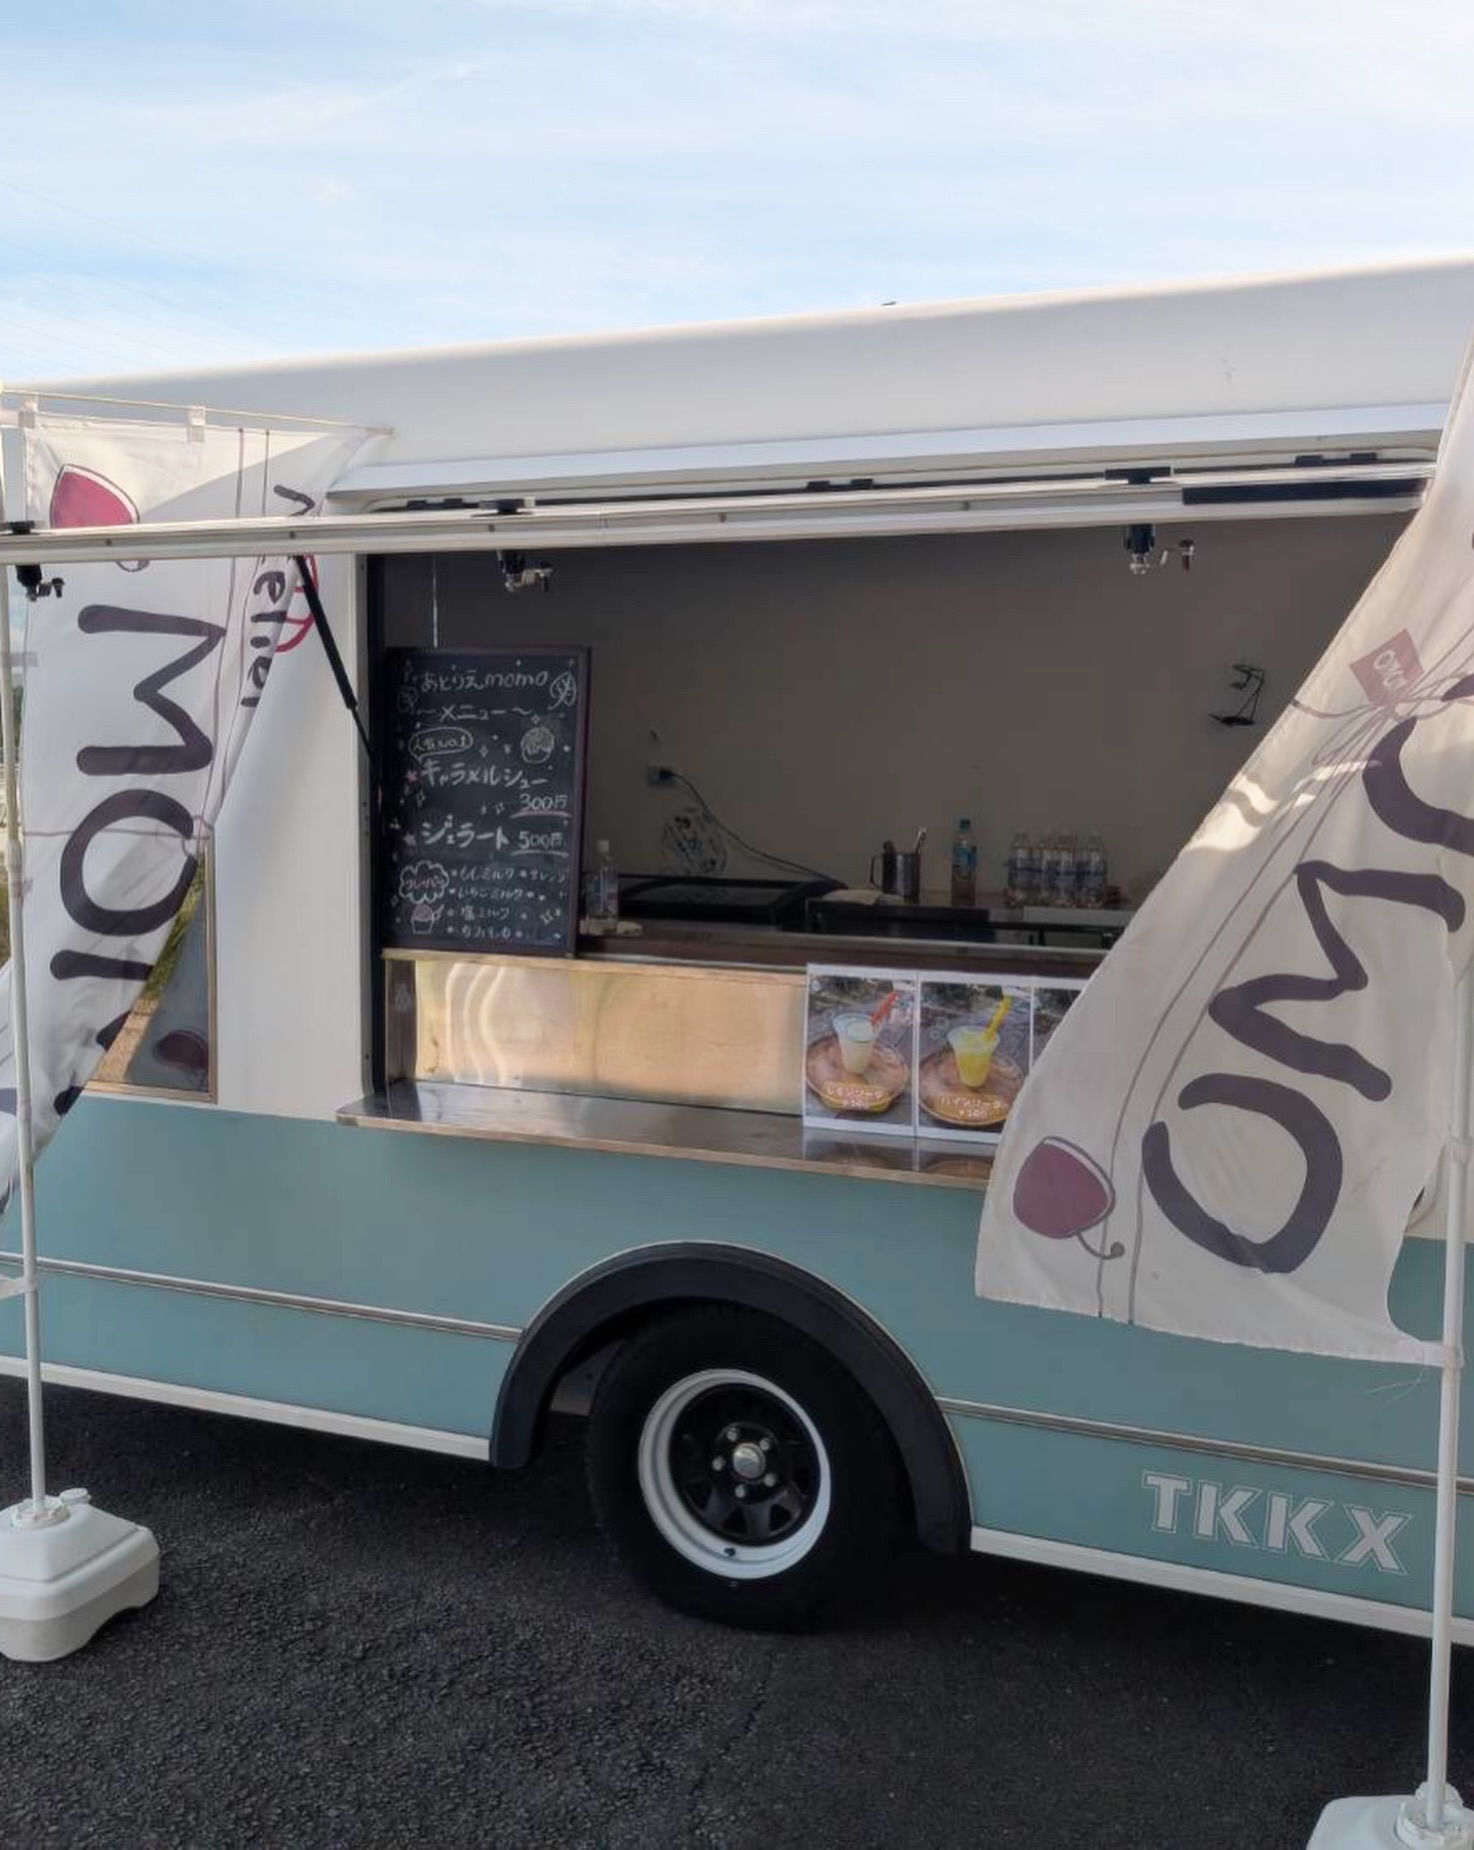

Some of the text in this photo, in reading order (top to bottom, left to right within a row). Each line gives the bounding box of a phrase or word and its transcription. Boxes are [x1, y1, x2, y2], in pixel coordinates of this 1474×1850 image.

[419, 759, 549, 789] キャラメルシュー
[519, 793, 569, 812] 300円
[420, 814, 567, 850] ジェラート 500円
[1141, 1468, 1413, 1577] TKKX
